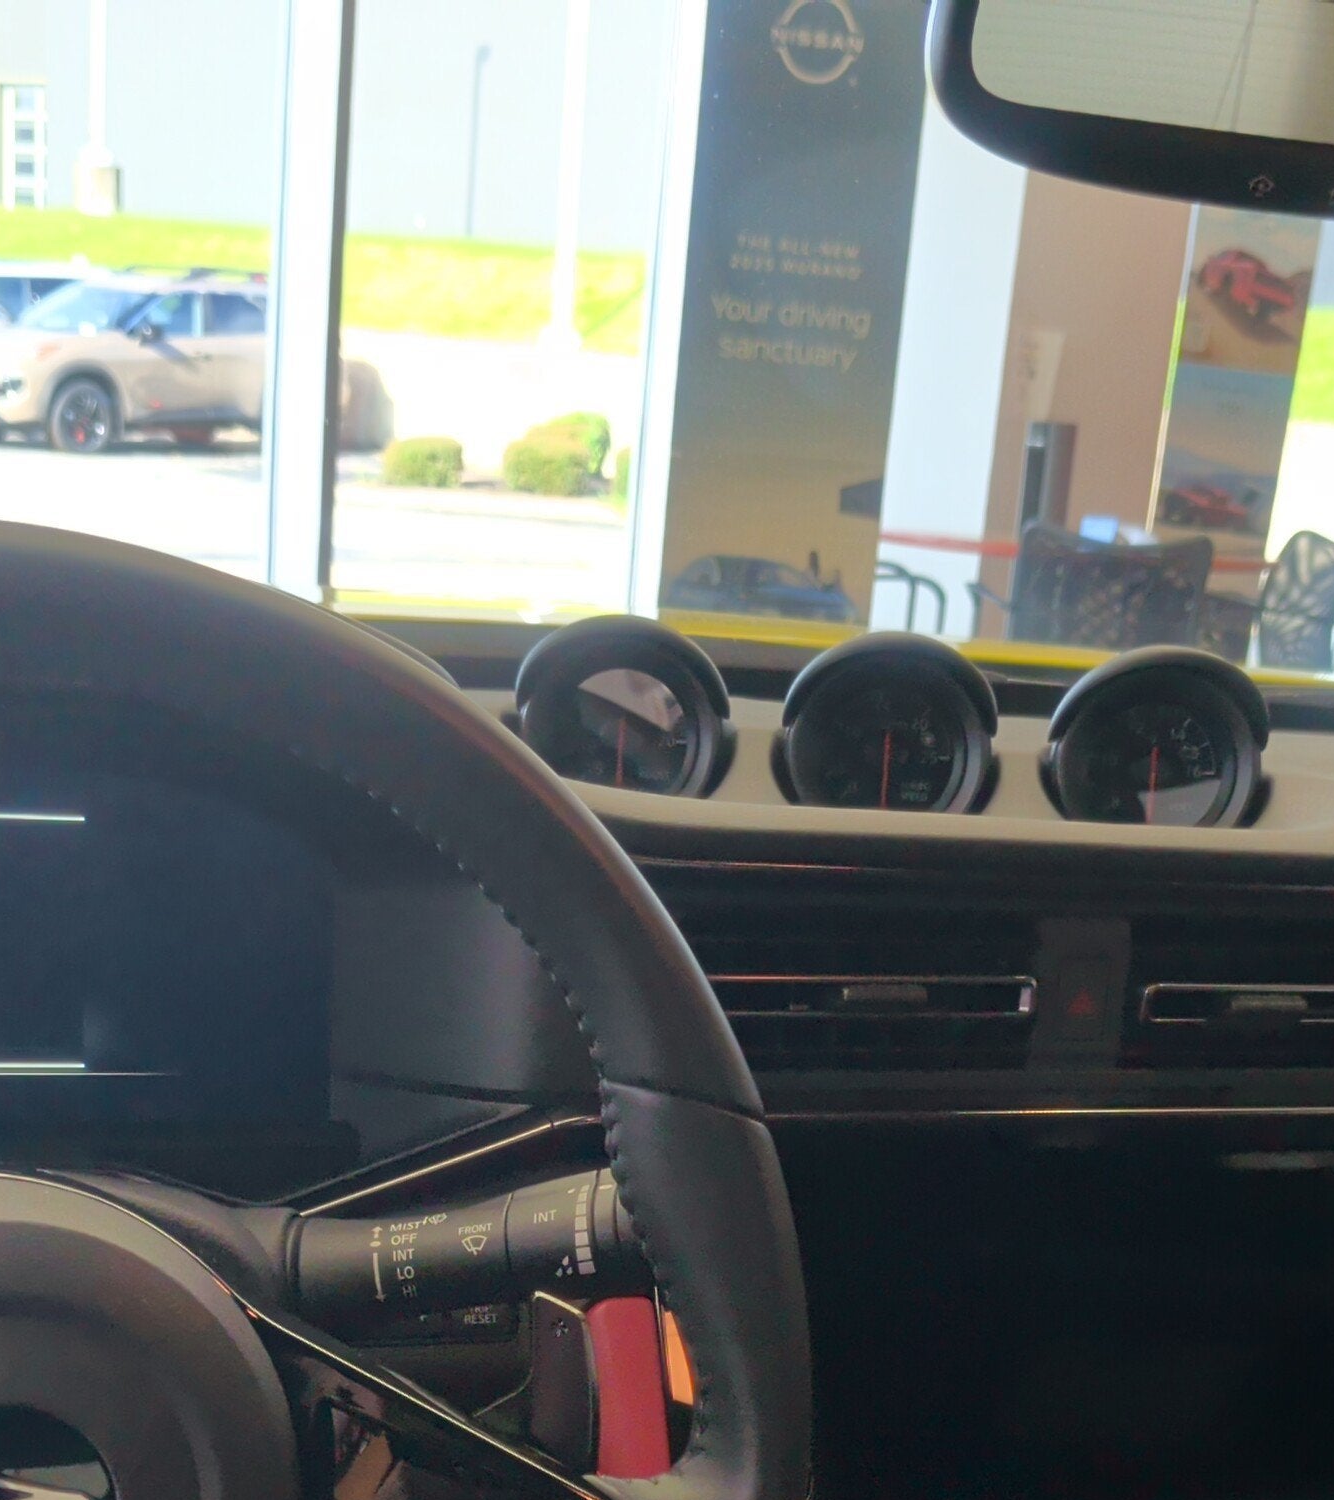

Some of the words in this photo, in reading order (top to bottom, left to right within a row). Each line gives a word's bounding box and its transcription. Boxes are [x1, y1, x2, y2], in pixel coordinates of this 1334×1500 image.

[711, 295, 773, 323] Your
[778, 302, 871, 340] driving
[720, 335, 858, 372] sanctuary
[533, 1209, 557, 1224] INT
[390, 1220, 421, 1232] MIST
[458, 1222, 493, 1236] FRONT
[391, 1232, 417, 1246] OFF
[392, 1248, 415, 1262] INT
[397, 1265, 415, 1280] LO
[464, 1313, 498, 1325] RESET
